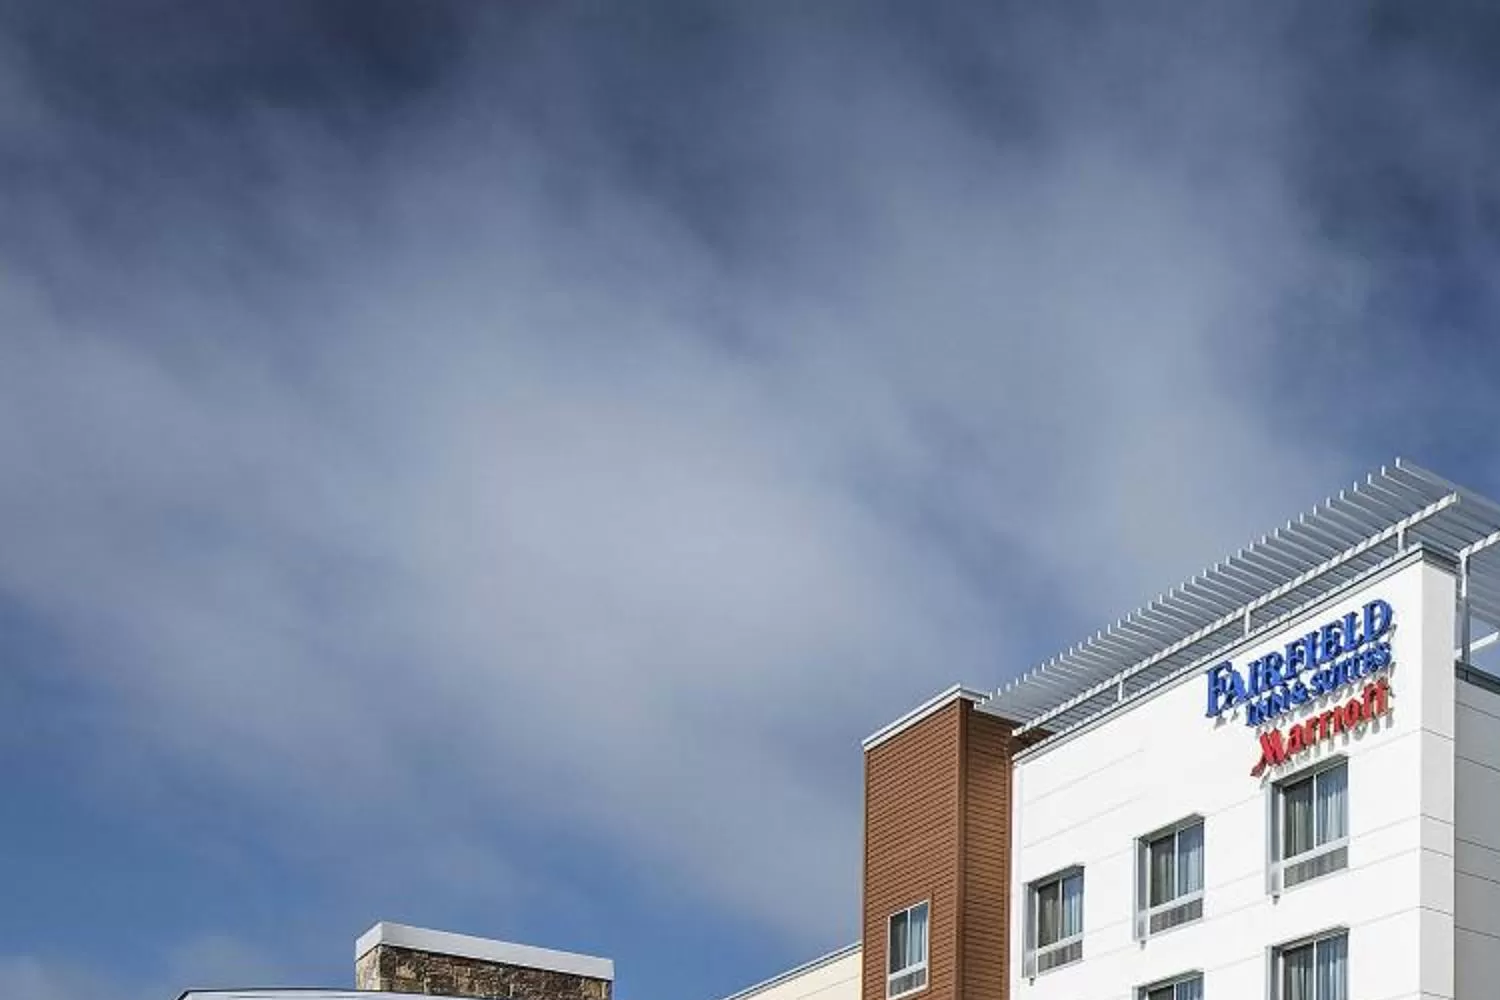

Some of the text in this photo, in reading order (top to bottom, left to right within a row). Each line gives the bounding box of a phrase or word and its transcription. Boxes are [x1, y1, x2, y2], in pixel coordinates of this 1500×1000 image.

[1205, 600, 1393, 718] FAIRFIELD
[1246, 641, 1391, 727] INN & SUITES
[1250, 676, 1390, 776] Marriott
